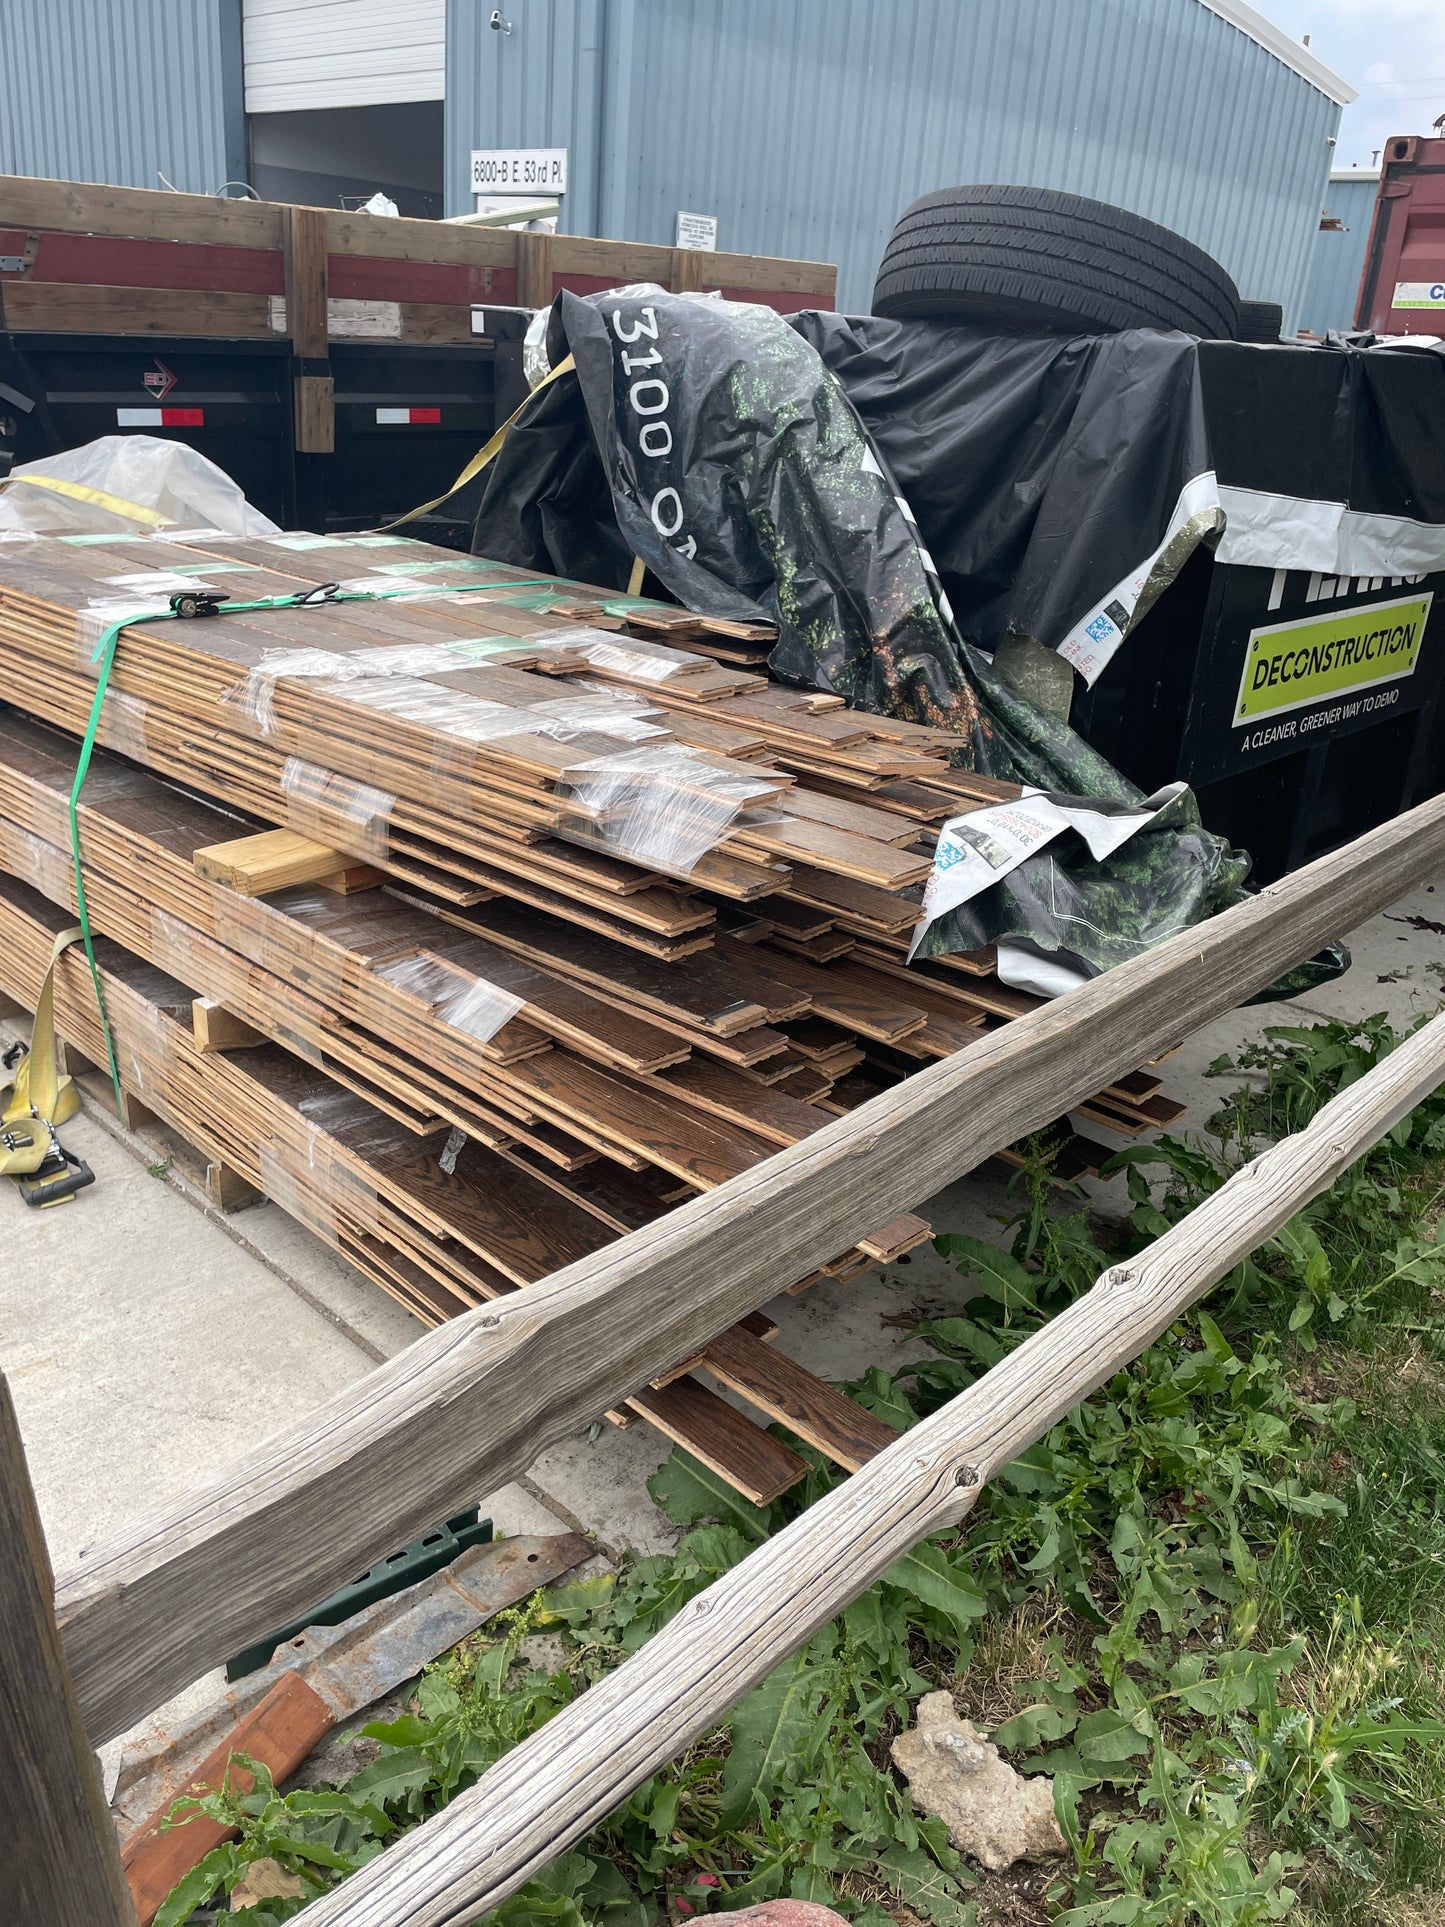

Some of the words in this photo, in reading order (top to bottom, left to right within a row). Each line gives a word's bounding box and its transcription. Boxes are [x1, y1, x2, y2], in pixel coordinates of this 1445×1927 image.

[474, 160, 508, 182] 6800-B
[524, 160, 548, 183] 53rd
[612, 307, 674, 457] 3100
[1252, 622, 1417, 691] DECONSTRUCTION
[1241, 735, 1250, 752] A
[1252, 720, 1298, 749] CLEANER,
[1300, 706, 1342, 733] GREENER
[1342, 699, 1361, 720] WAY
[1362, 696, 1375, 713] TO
[1374, 689, 1400, 709] DEMO
